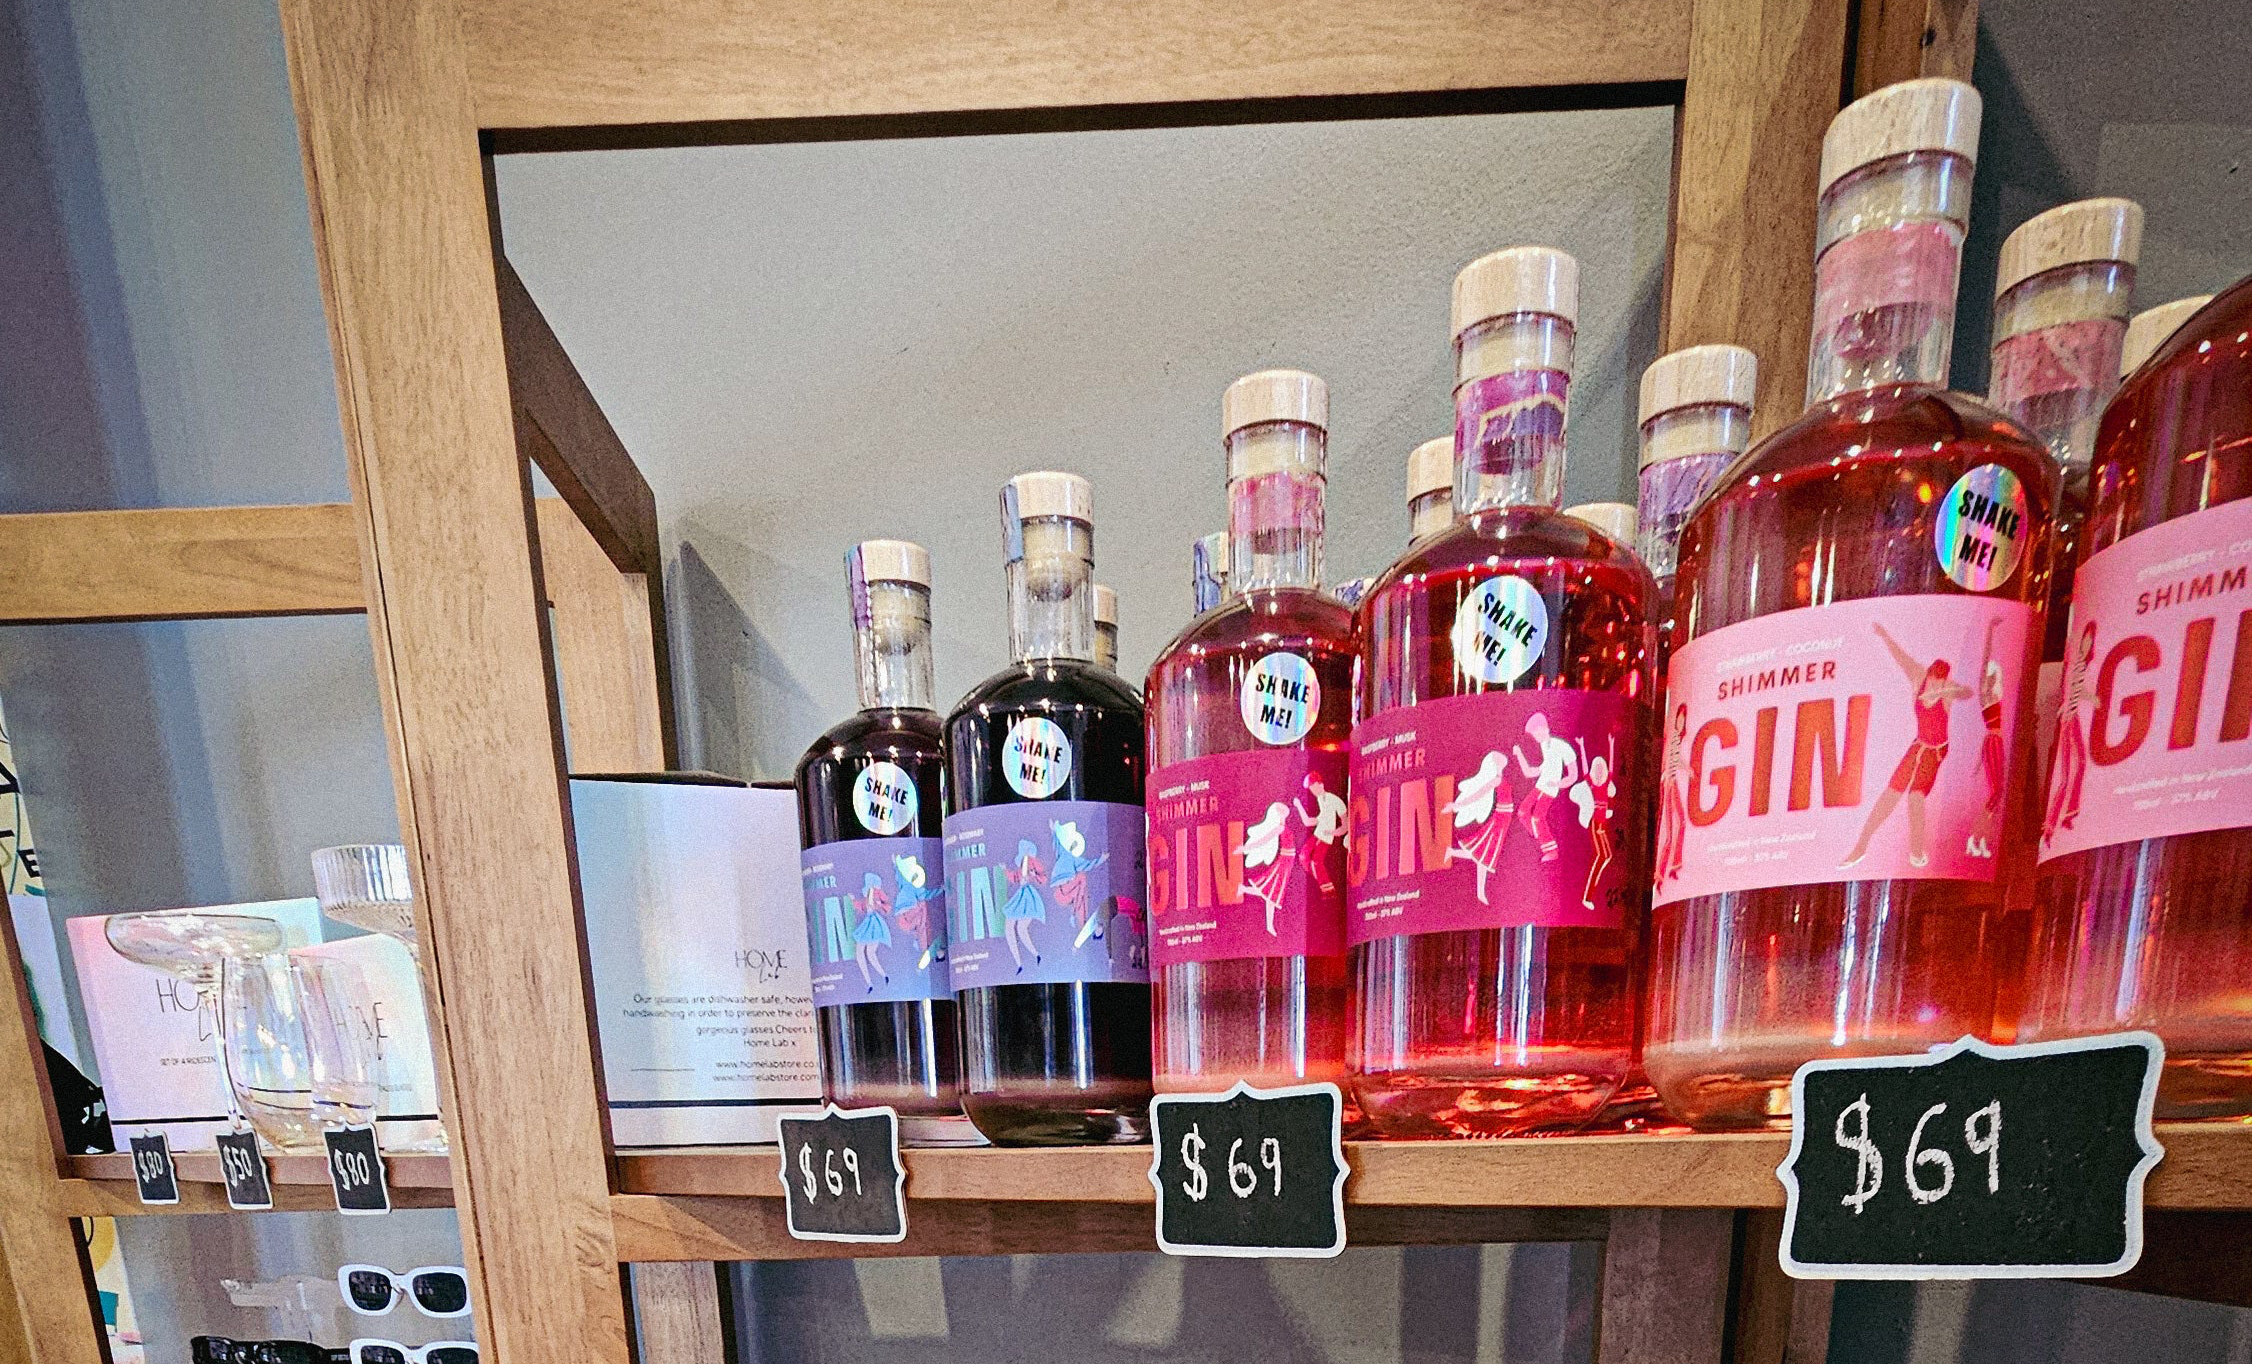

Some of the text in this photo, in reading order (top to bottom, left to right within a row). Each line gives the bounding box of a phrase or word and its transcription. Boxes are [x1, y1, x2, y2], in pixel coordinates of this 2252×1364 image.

[1958, 490, 2019, 541] SHAKE
[1959, 533, 1998, 572] ME!
[1478, 592, 1539, 647] SHAKE
[1473, 631, 1506, 667] ME!
[1256, 673, 1310, 704] SHAKE
[1717, 661, 1837, 700] SHIMMER
[1260, 704, 1292, 729] ME!
[1014, 736, 1062, 763] SHAKE
[1687, 694, 1872, 827] GIN
[865, 776, 908, 805] SHAKE
[1019, 762, 1047, 784] ME!
[868, 801, 893, 822] ME!
[1150, 820, 1244, 916] GIN
[743, 1038, 770, 1048] Home
[772, 1038, 789, 1048] Lab
[137, 1149, 163, 1183] $80
[223, 1144, 252, 1188] $50
[334, 1148, 370, 1191] $80
[799, 1142, 862, 1204] $69
[1180, 1123, 1282, 1202] $69
[1835, 1092, 2003, 1215] $69
